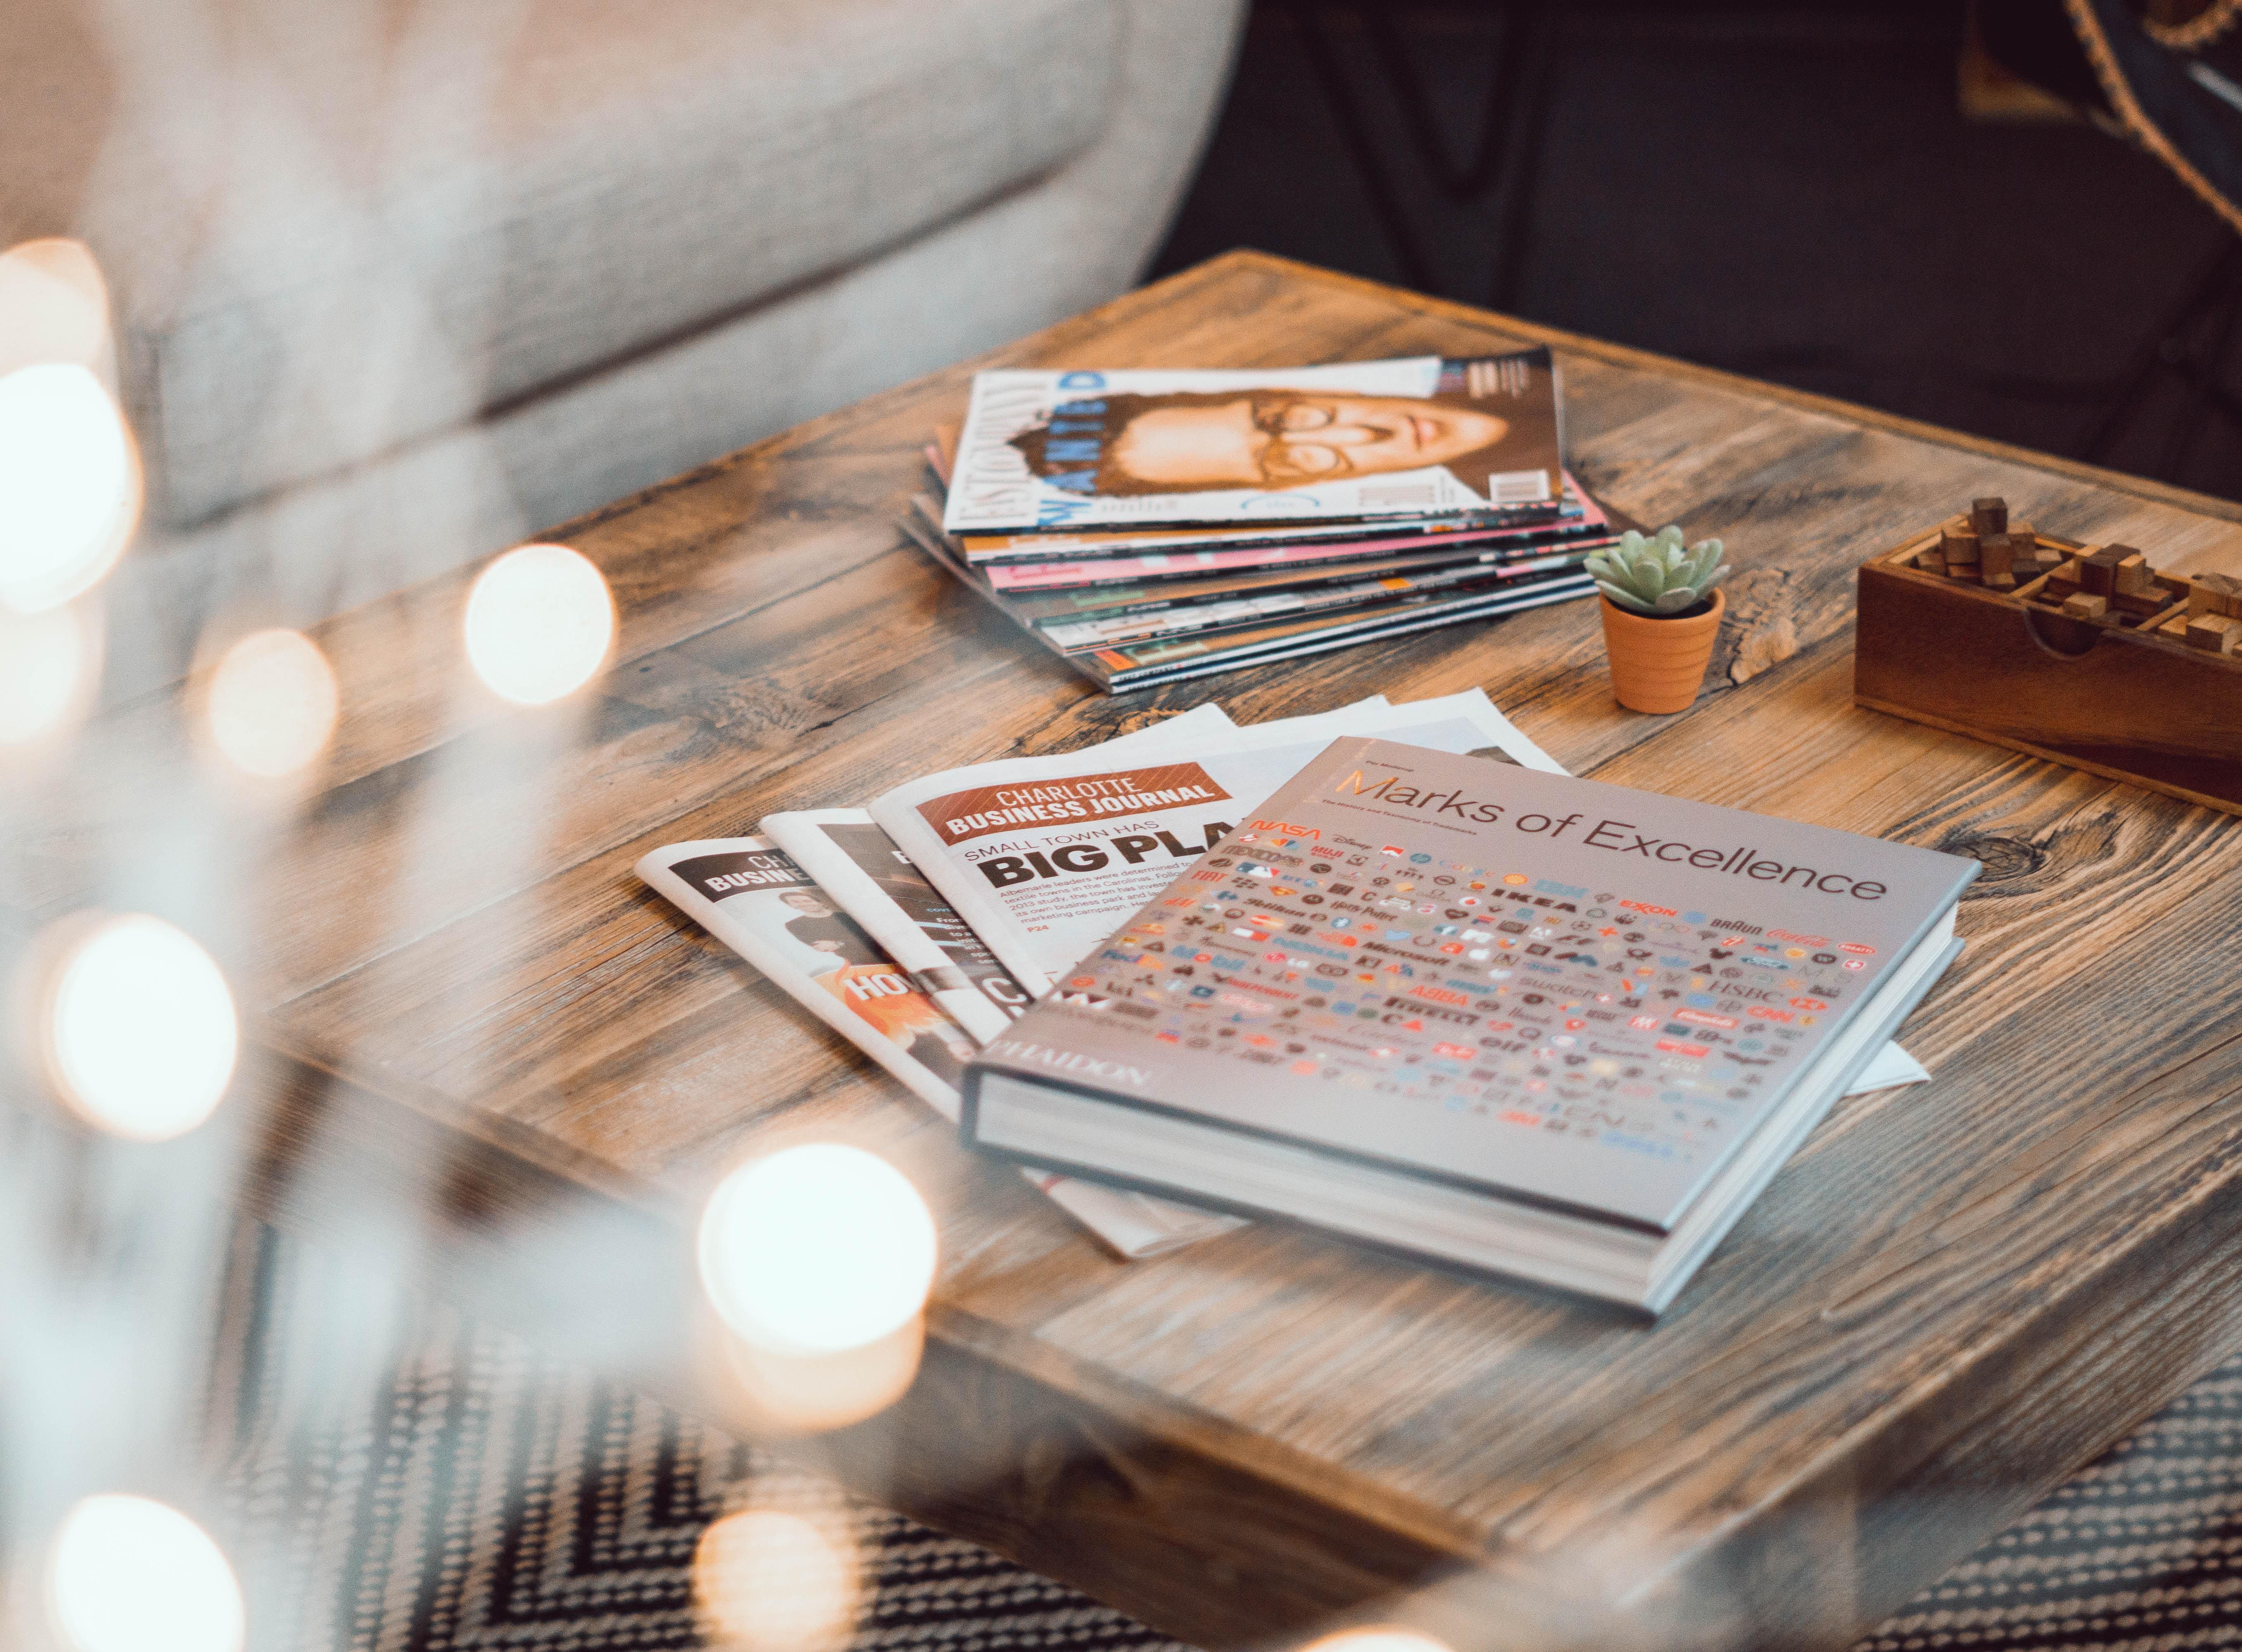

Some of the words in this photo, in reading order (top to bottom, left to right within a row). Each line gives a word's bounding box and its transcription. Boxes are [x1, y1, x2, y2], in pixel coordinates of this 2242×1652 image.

[995, 777, 1142, 807] CHARLOTTE
[945, 800, 1089, 835] BUSINESS
[1092, 784, 1216, 813] JOURNAL
[1337, 802, 1365, 811] History
[1432, 822, 1477, 835] Trademarks
[965, 840, 1039, 862] SMALL
[1043, 828, 1110, 845] TOWN
[1114, 820, 1159, 834] HAS
[1249, 819, 1321, 840] NASA
[1335, 769, 1505, 823] Marks
[1515, 813, 1583, 838] of
[1583, 819, 1888, 900] Excellence
[1310, 845, 1344, 857] MUJI
[976, 844, 1109, 889] BIG
[1000, 883, 1052, 898] Albemarle
[1053, 876, 1092, 888] leaders
[1093, 873, 1119, 881] were
[1121, 862, 1180, 877] determined
[1004, 892, 1037, 904] textile
[1039, 887, 1070, 898] towns
[1072, 884, 1082, 893] in
[1083, 881, 1101, 890] the
[1103, 875, 1154, 888] Carolinas.
[1010, 900, 1035, 911] 2013
[1089, 888, 1115, 897] town
[1117, 885, 1135, 893] has
[1191, 870, 1229, 882] FIAT
[1491, 888, 1577, 913] IKEA
[1015, 909, 1028, 917] its
[1054, 898, 1100, 911] business
[1102, 895, 1125, 905] park
[1126, 892, 1146, 900] and
[1021, 911, 1073, 924] marketing
[1075, 903, 1129, 916] campaign.
[1026, 924, 1049, 933] P24
[1363, 941, 1450, 966] Microsoft
[1707, 981, 1784, 1003] HSBC
[1746, 1005, 1796, 1024] CNN
